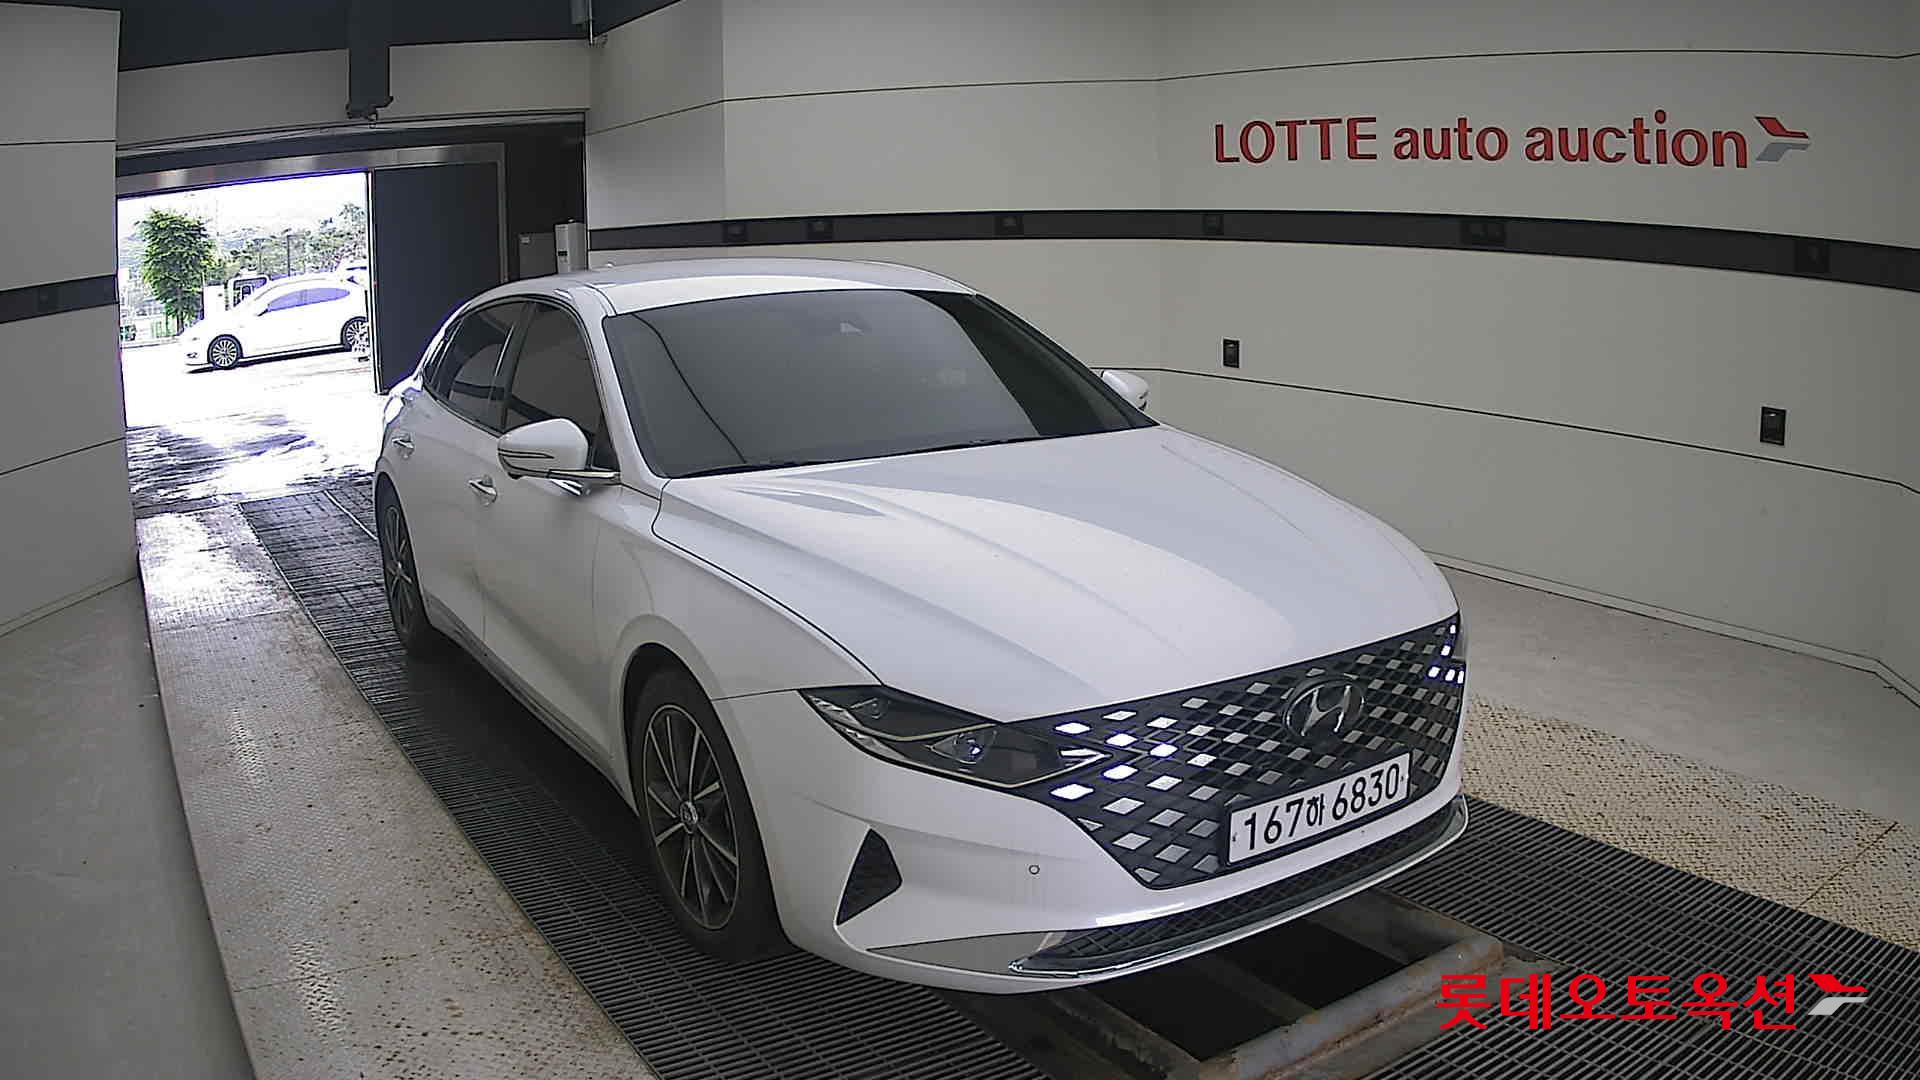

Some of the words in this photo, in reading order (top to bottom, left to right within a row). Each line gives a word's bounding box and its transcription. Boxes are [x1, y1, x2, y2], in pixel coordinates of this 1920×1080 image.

[1215, 116, 1377, 164] LOTTE
[1393, 116, 1508, 161] auto
[1525, 109, 1748, 168] auction
